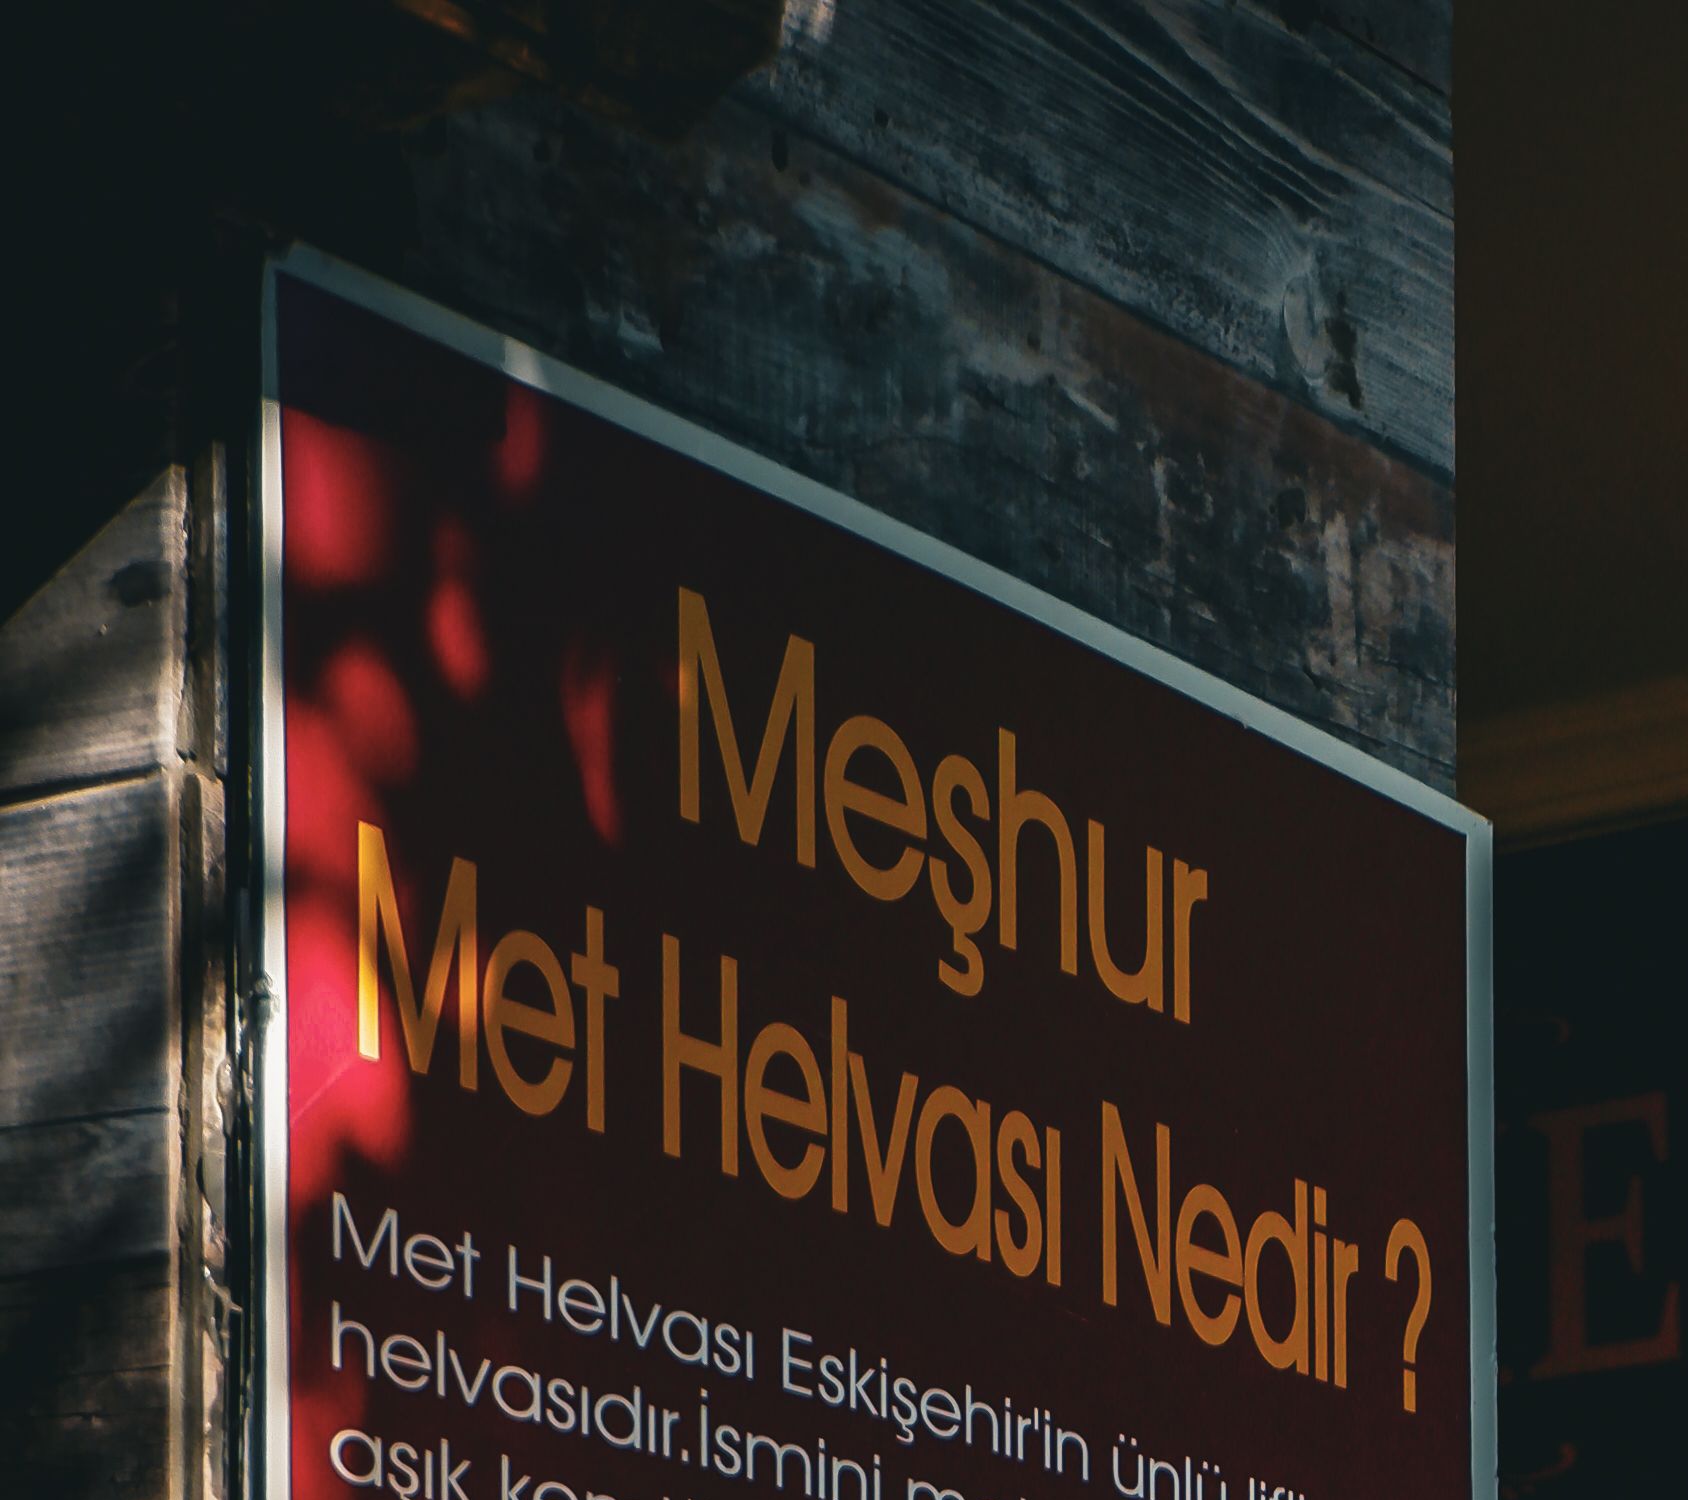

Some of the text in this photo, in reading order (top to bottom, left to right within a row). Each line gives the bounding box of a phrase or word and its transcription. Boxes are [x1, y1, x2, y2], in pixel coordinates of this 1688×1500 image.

[678, 587, 1207, 1026] Meşhur
[357, 821, 619, 1134] Met
[662, 936, 1062, 1287] Helvası
[1102, 1102, 1358, 1388] Nedir
[330, 1194, 480, 1299] Met
[507, 1244, 757, 1380] Helvası
[780, 1329, 1092, 1481] Eskişehir'in
